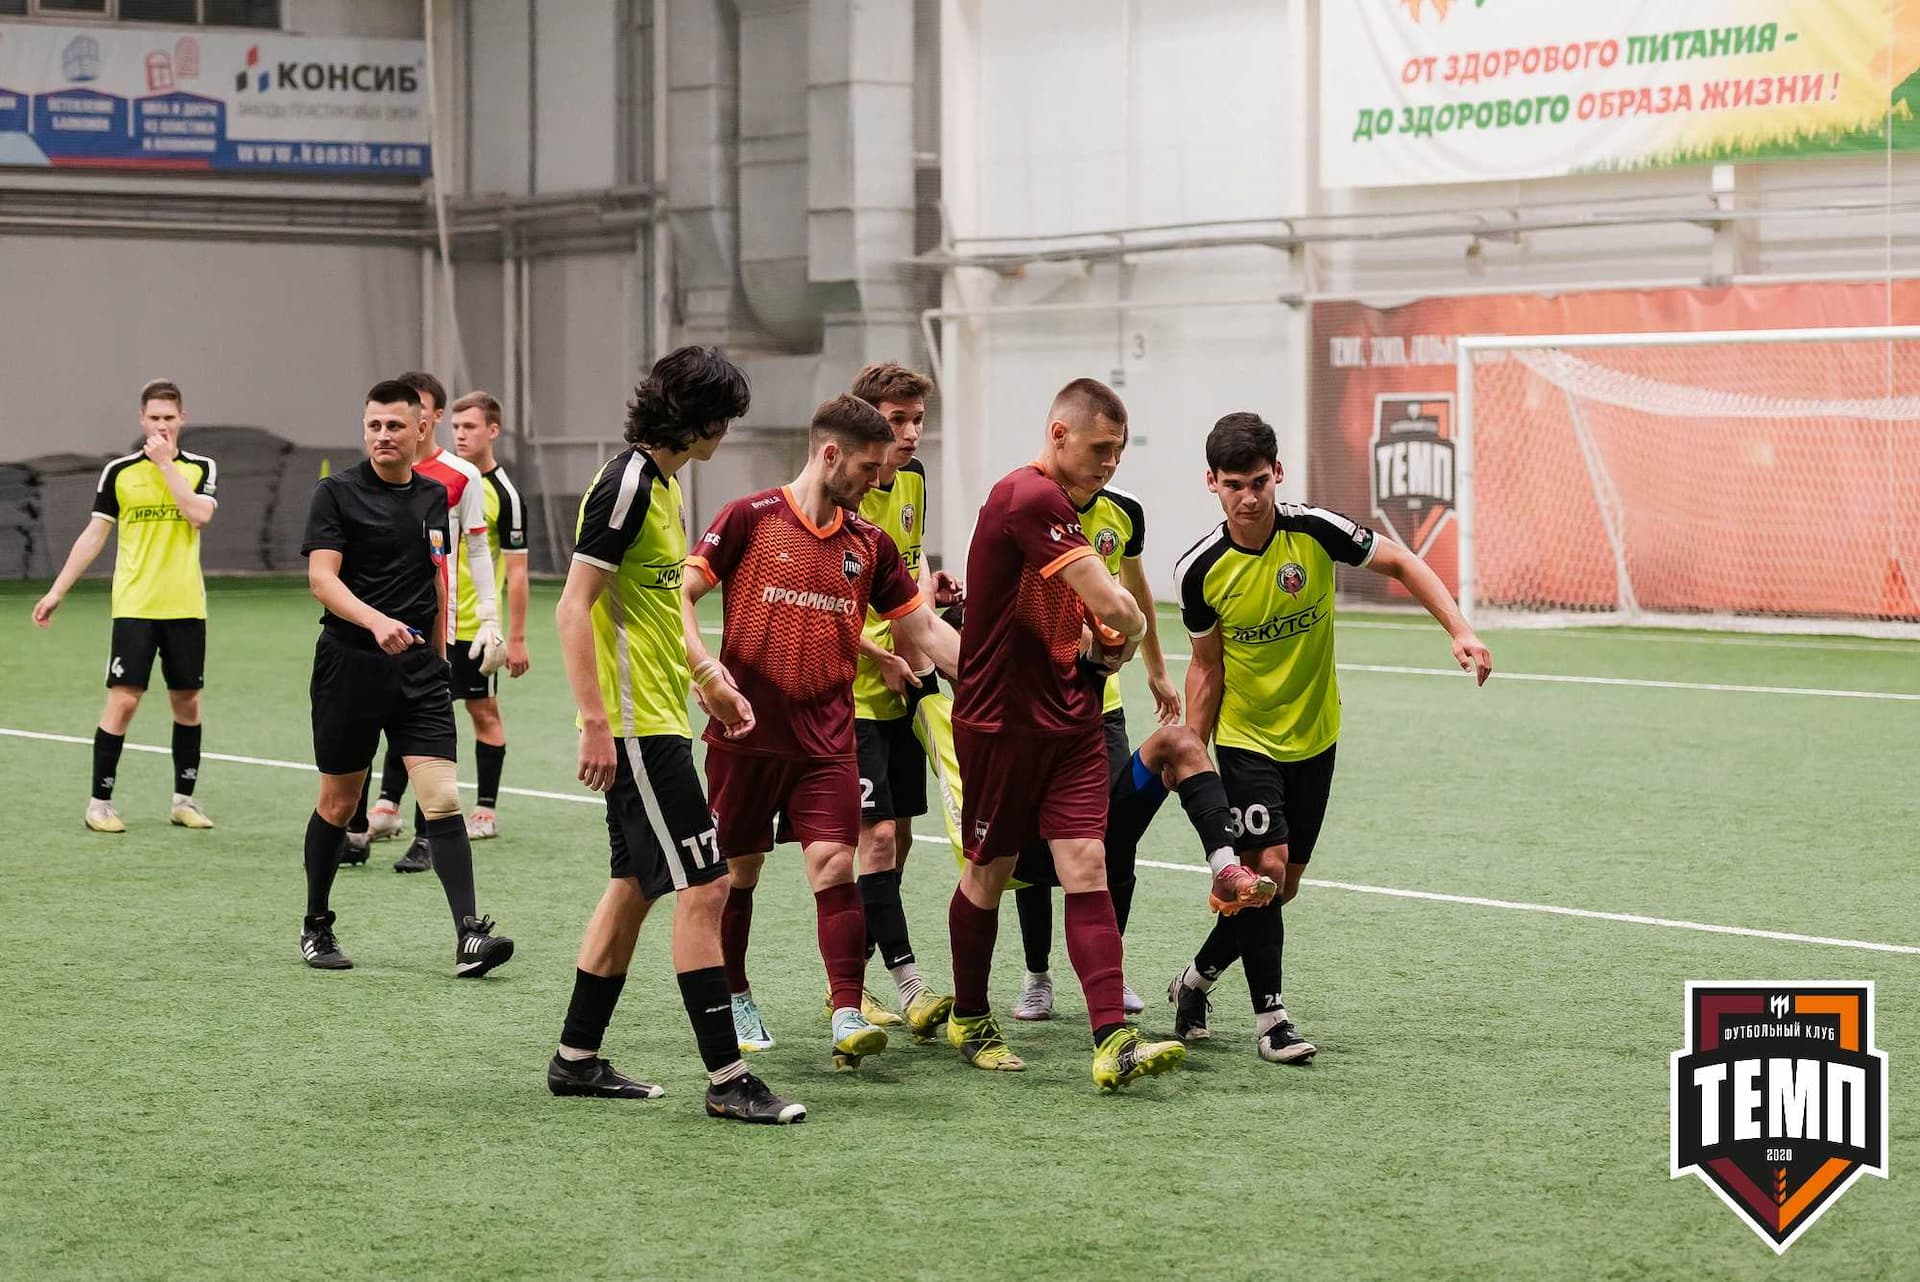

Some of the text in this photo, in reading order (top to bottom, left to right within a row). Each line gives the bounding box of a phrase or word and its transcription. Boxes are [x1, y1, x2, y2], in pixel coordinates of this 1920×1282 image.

[1402, 57, 1437, 84] ОТ
[1444, 39, 1619, 85] ЗДОРОВОГО
[1626, 22, 1777, 65] ПИТАНИЯ
[277, 62, 418, 93] КОНСИБ
[1352, 108, 1394, 142] ДО
[1399, 94, 1570, 138] ЗДОРОВОГО
[1577, 84, 1692, 121] ОБРАЗА
[1700, 74, 1824, 111] ЖИЗНИ
[237, 143, 421, 166] www.konsib.com
[1376, 441, 1455, 500] ТЕМП
[762, 586, 857, 615] ПРОДИНВЕСТ
[111, 656, 124, 678] 4
[681, 827, 720, 870] 17
